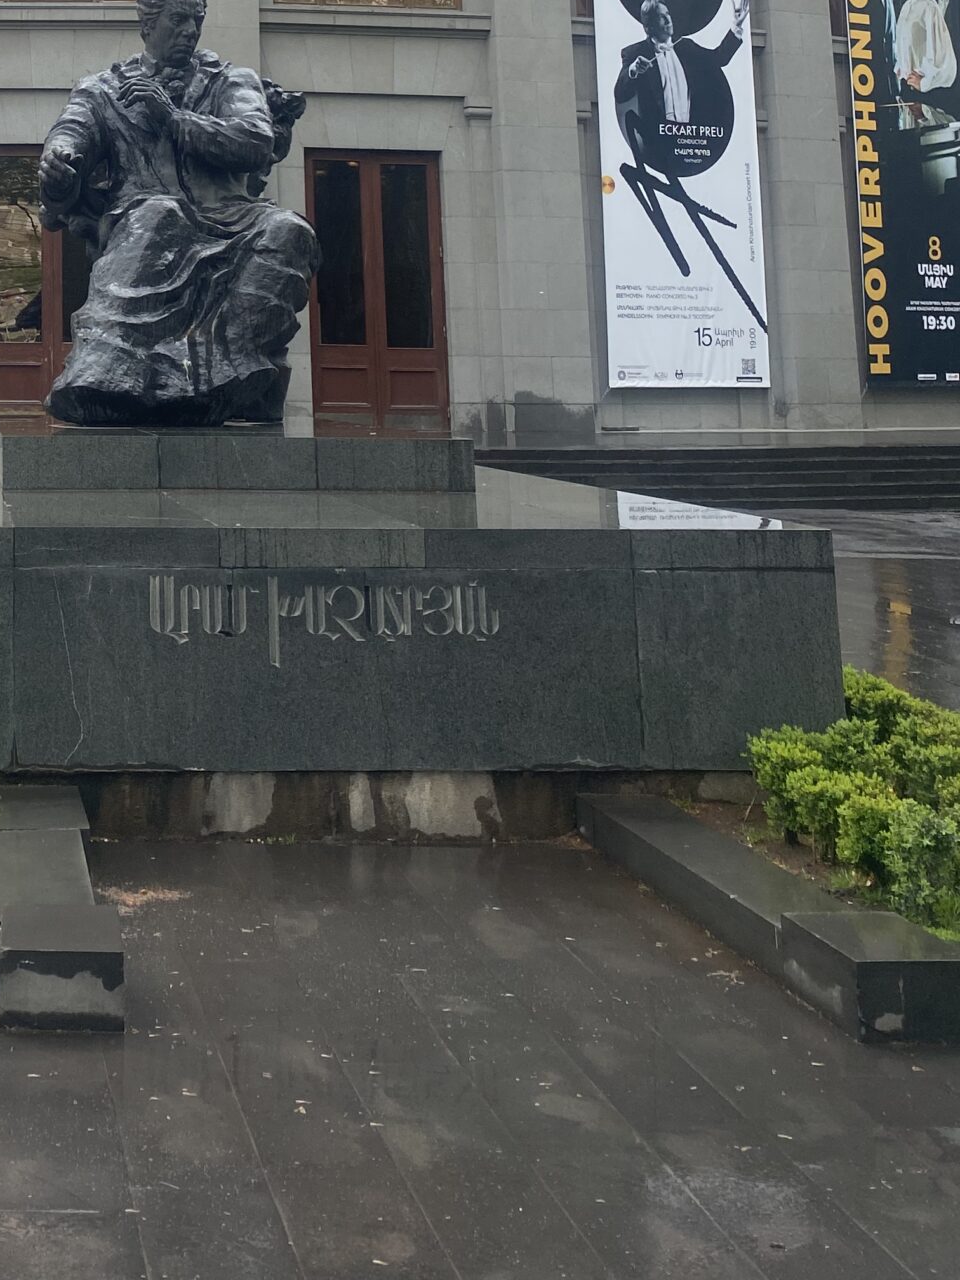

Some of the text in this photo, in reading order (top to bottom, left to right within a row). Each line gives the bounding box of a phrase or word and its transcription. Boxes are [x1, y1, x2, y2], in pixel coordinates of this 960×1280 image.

[659, 124, 724, 138] ECKART PREU
[928, 236, 941, 261] 8
[917, 263, 954, 276] ՄԱՅԻՍ
[924, 276, 948, 289] MAY
[922, 315, 956, 330] 19:30
[693, 327, 713, 347] 15
[715, 337, 734, 347] April
[749, 328, 757, 349] 19:00
